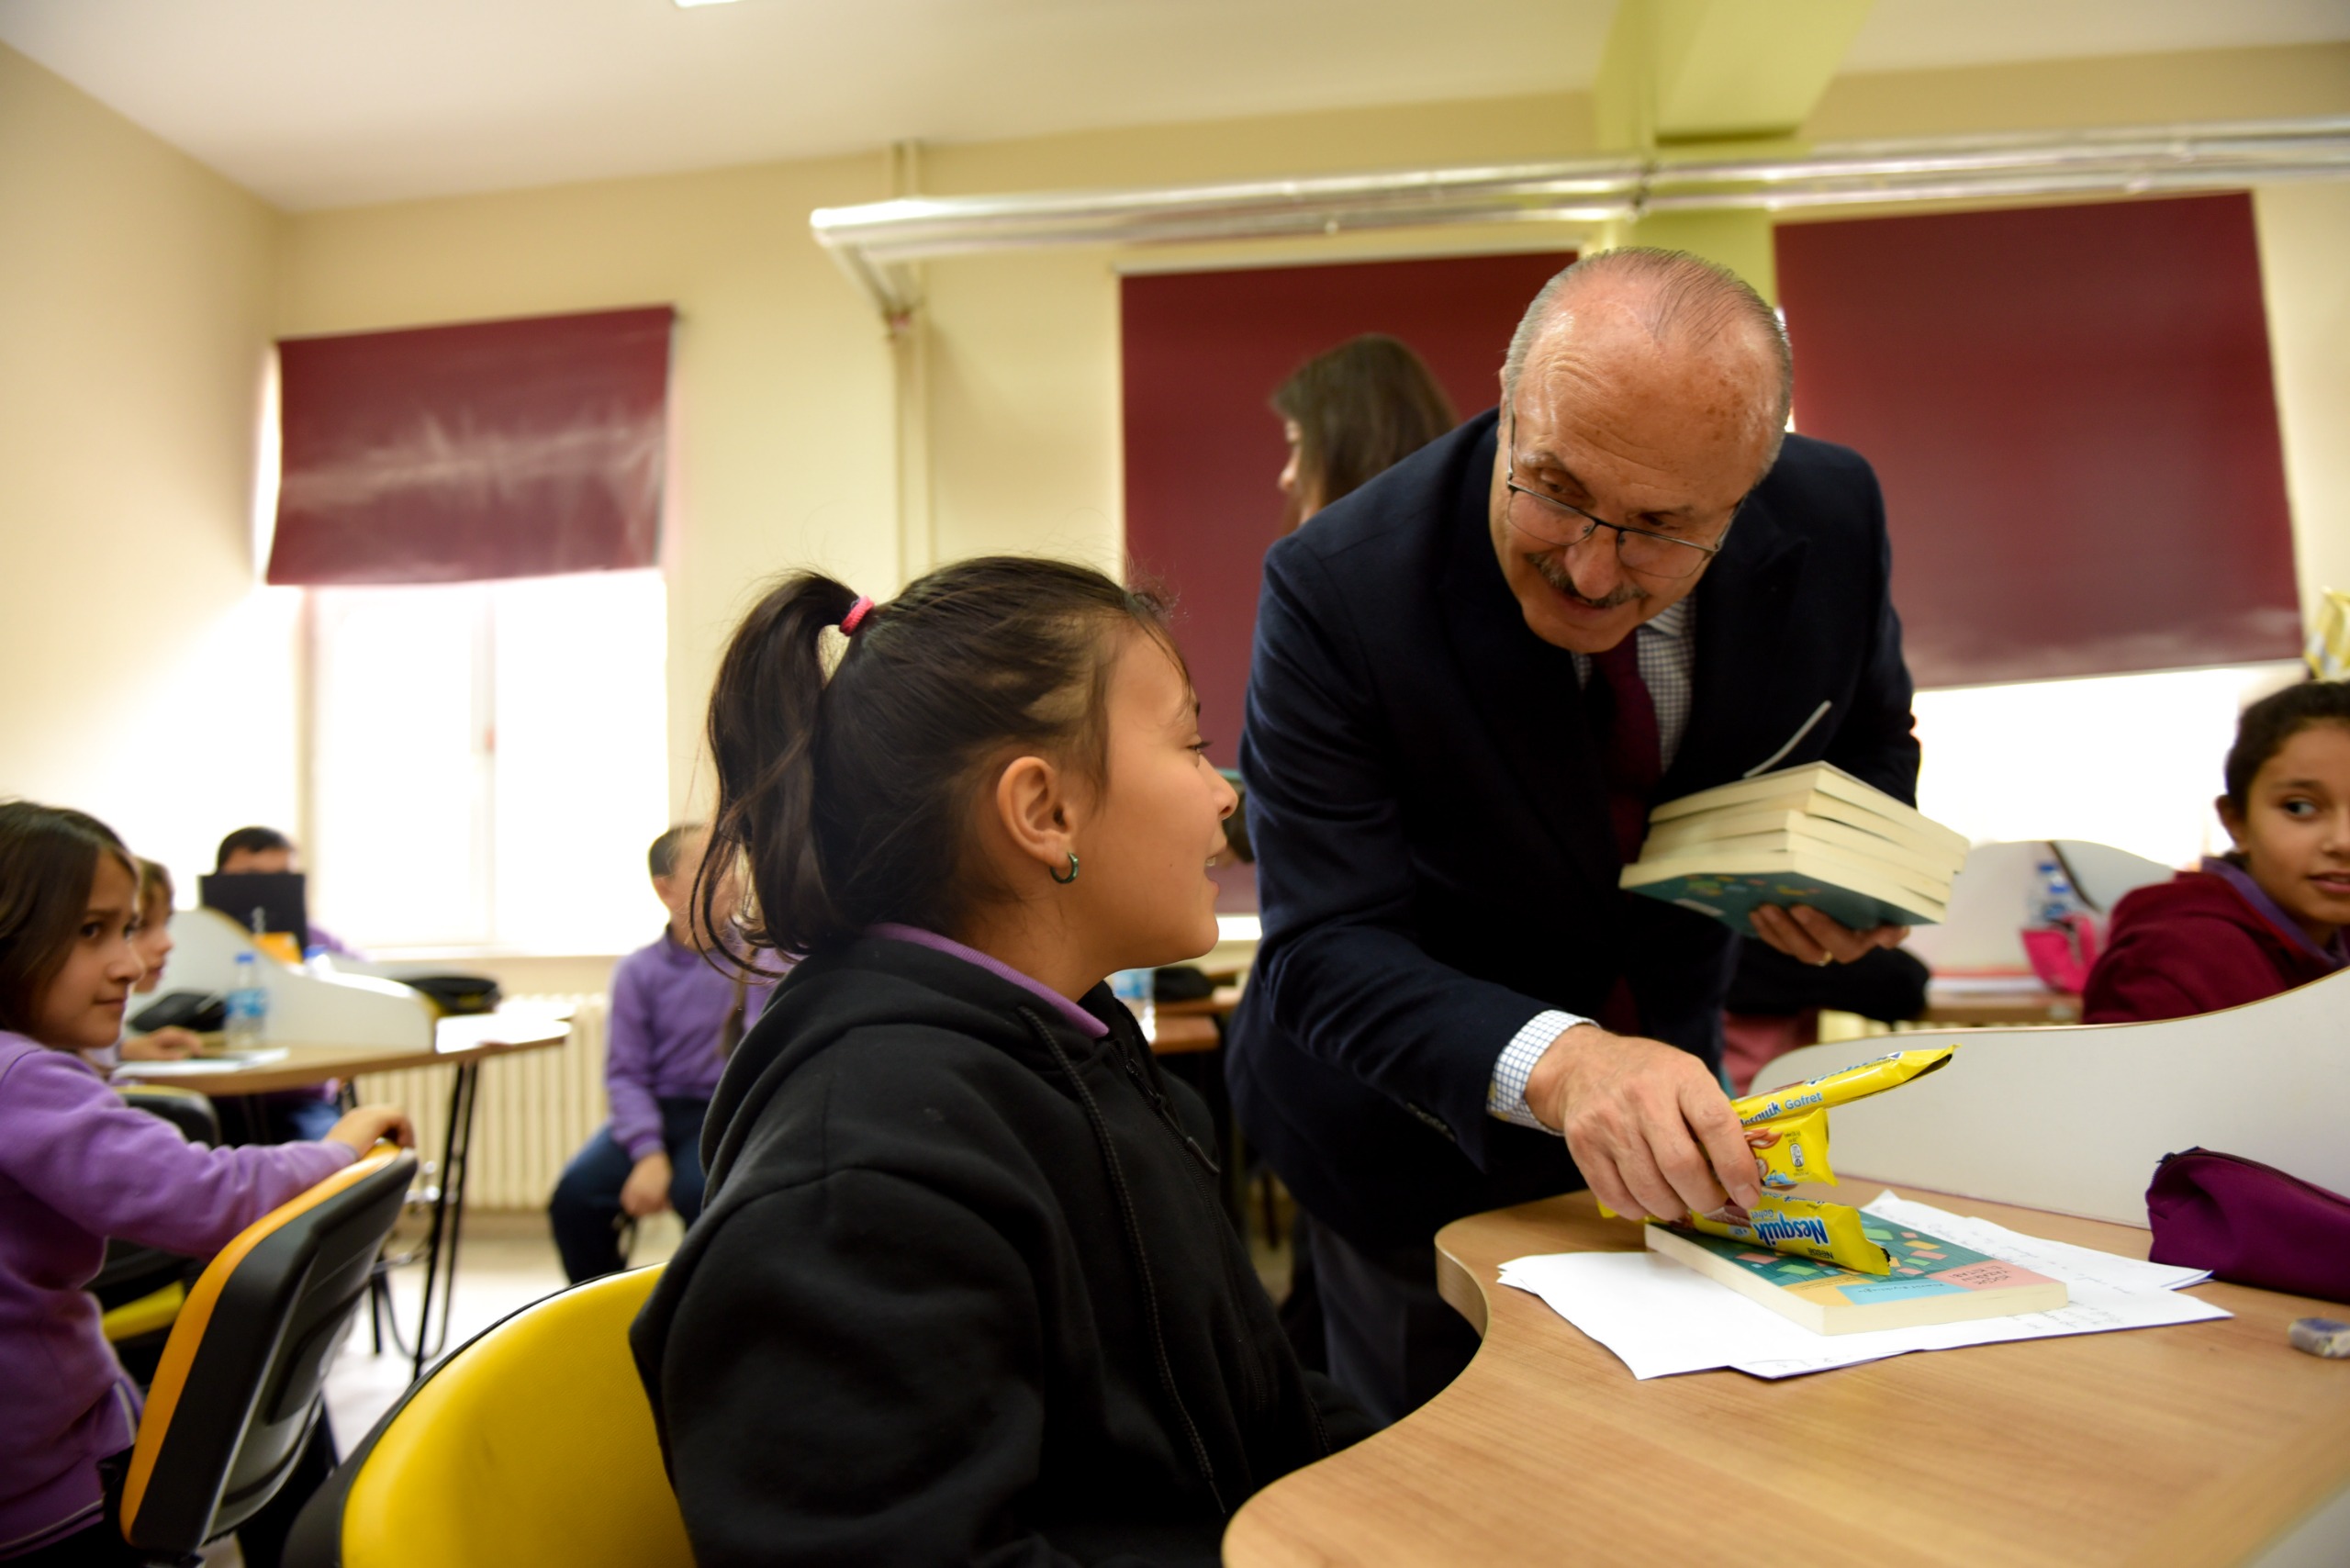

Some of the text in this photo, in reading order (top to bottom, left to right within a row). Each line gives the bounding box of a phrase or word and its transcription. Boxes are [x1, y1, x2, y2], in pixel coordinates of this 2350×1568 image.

[1785, 1092, 1823, 1110] Gofret
[1751, 1208, 1774, 1219] Gofret
[1754, 1212, 1830, 1247] Nesquik
